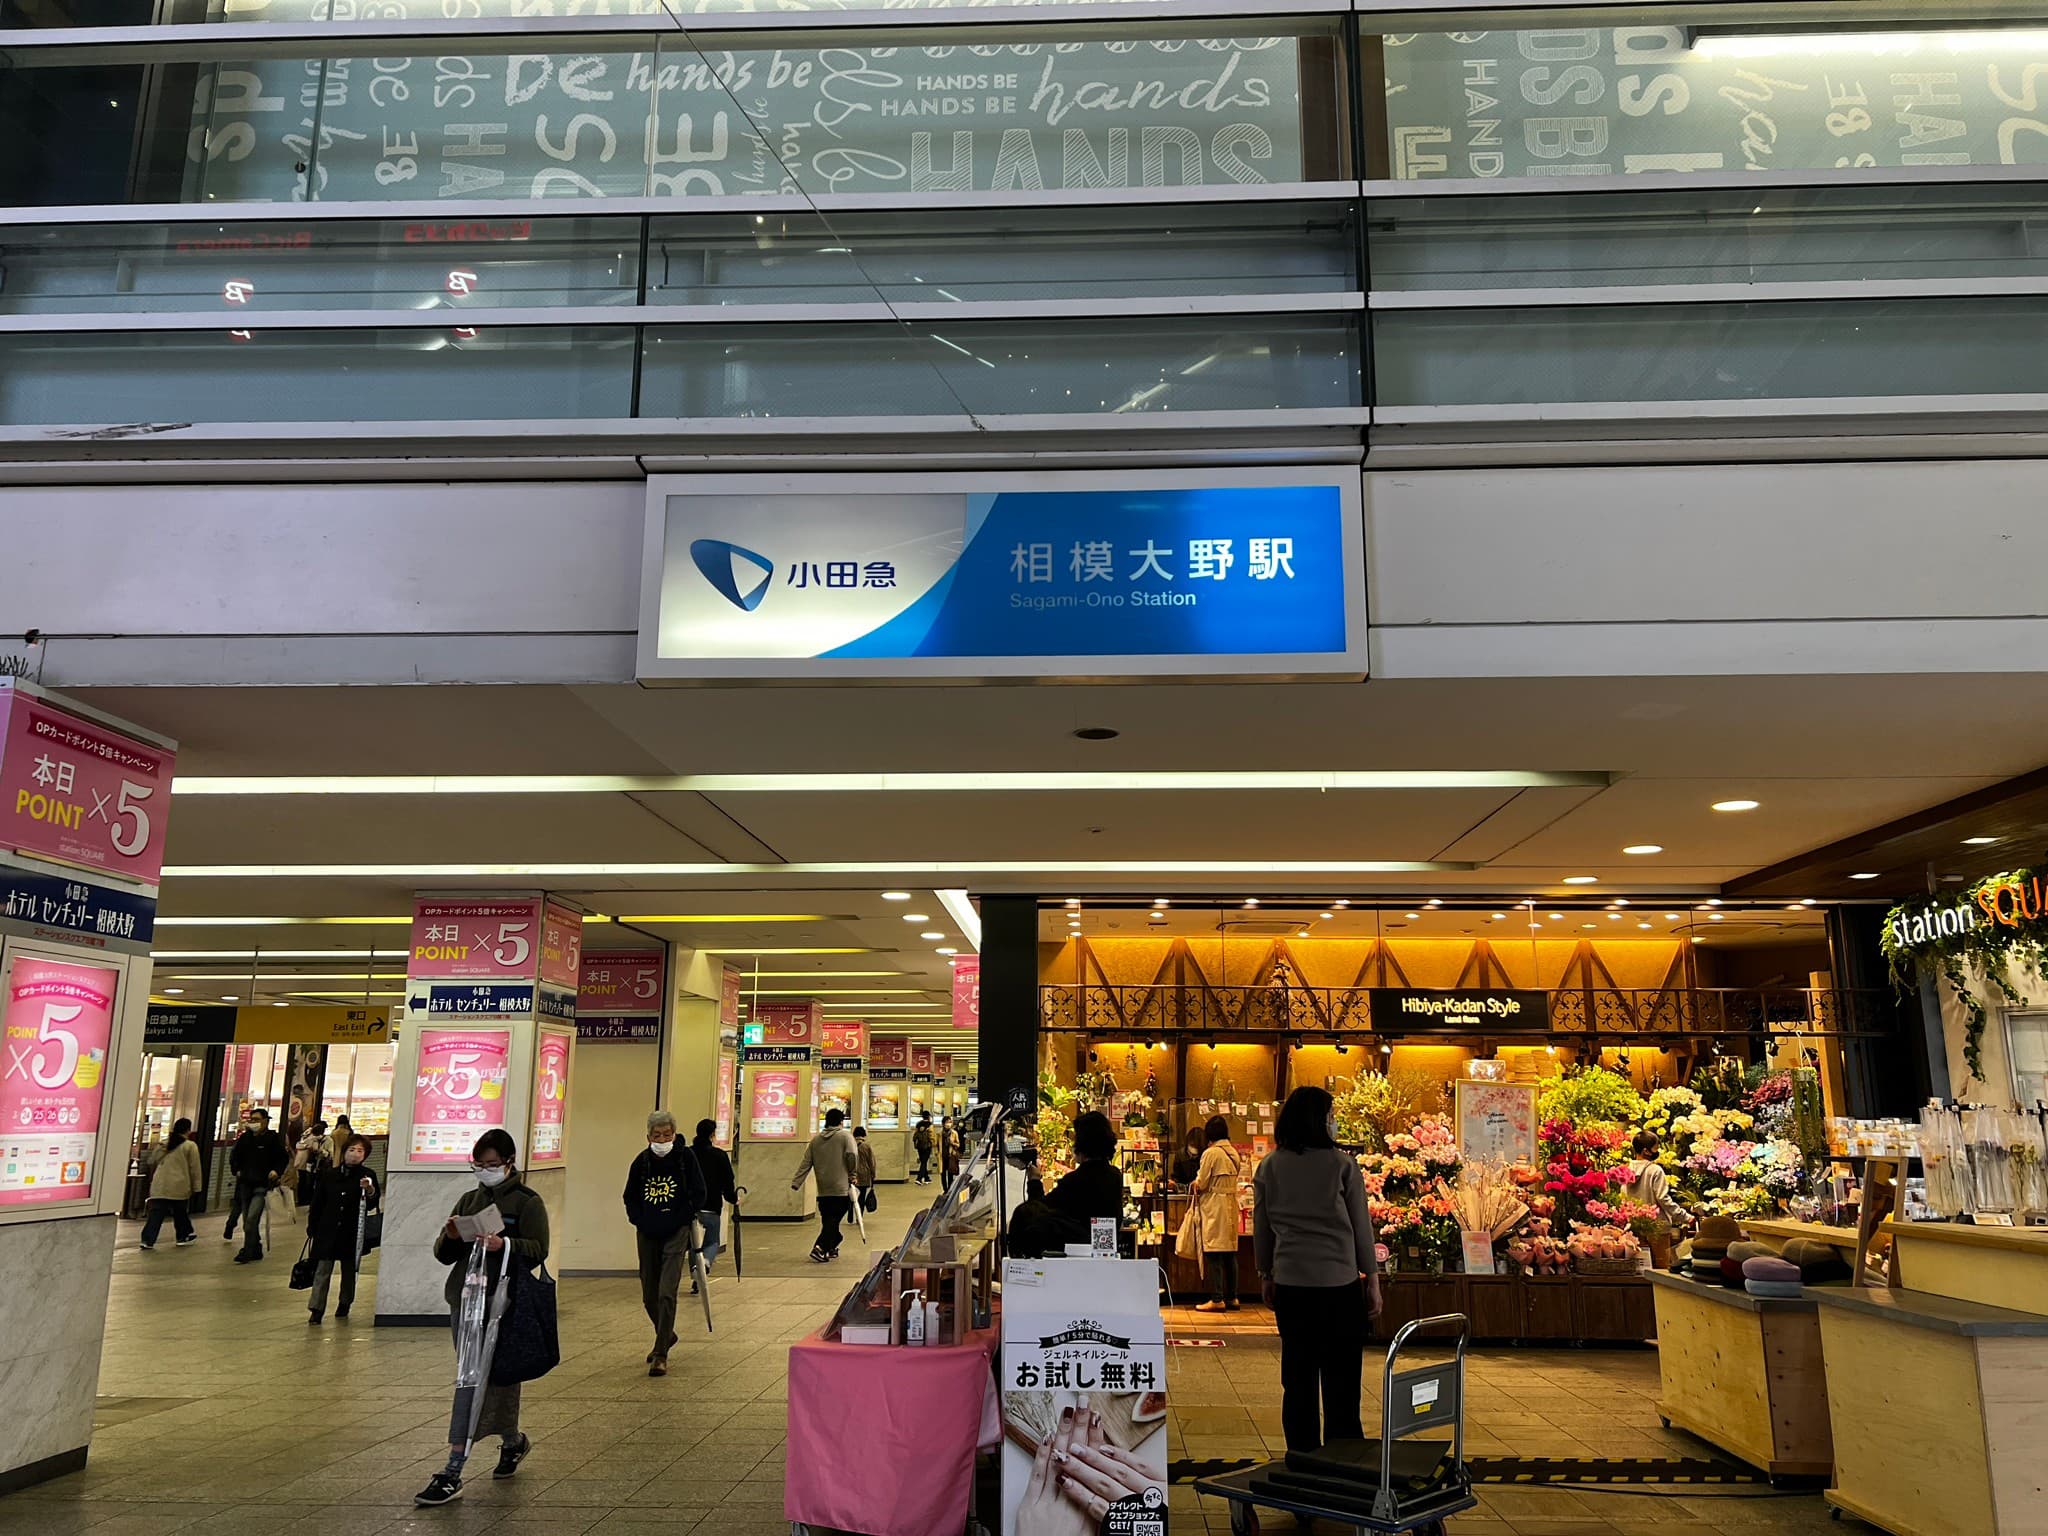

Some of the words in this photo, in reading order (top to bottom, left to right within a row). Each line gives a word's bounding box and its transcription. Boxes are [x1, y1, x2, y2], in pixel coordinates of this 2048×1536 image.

[916, 74, 989, 91] HANDS
[993, 73, 1019, 90] BE
[1027, 51, 1271, 126] hands
[880, 97, 976, 117] HANDS
[984, 96, 1017, 115] BE
[910, 122, 1273, 192] HANDS
[1010, 537, 1296, 583] 相模大野駅
[787, 561, 897, 589] 小田急
[1010, 591, 1125, 612] Sagami-Ono
[1130, 590, 1197, 607] Station
[35, 720, 155, 773] OPカードポイント5倍キャンペーン
[31, 753, 76, 796] 本日
[15, 788, 85, 831] POINT
[65, 882, 89, 903] 小田急
[5, 889, 38, 919] ホテル
[42, 896, 95, 928] センチュリー
[96, 907, 136, 939] 相模大野
[1891, 900, 1975, 948] station
[1977, 876, 2048, 928] SQU
[424, 924, 460, 943] 本日
[415, 945, 470, 961] POINT
[586, 970, 611, 983] 本日
[580, 984, 617, 995] POINT
[346, 1010, 366, 1021] 東口
[429, 998, 454, 1012] ホテル
[456, 998, 497, 1012] センチュリー
[499, 998, 531, 1012] 相模大野
[1401, 997, 1486, 1016] Hibiya-Kadan
[1486, 997, 1521, 1018] Style
[7, 1025, 38, 1040] POINT
[333, 1023, 348, 1031] East
[350, 1023, 365, 1031] Exit
[33, 1109, 45, 1120] 25
[46, 1109, 58, 1120] 26
[1043, 1349, 1129, 1360] ジェルネイルシール
[1016, 1360, 1156, 1391] お試し無料
[1109, 1501, 1143, 1511] ダイレクト
[1108, 1520, 1131, 1531] GET!
